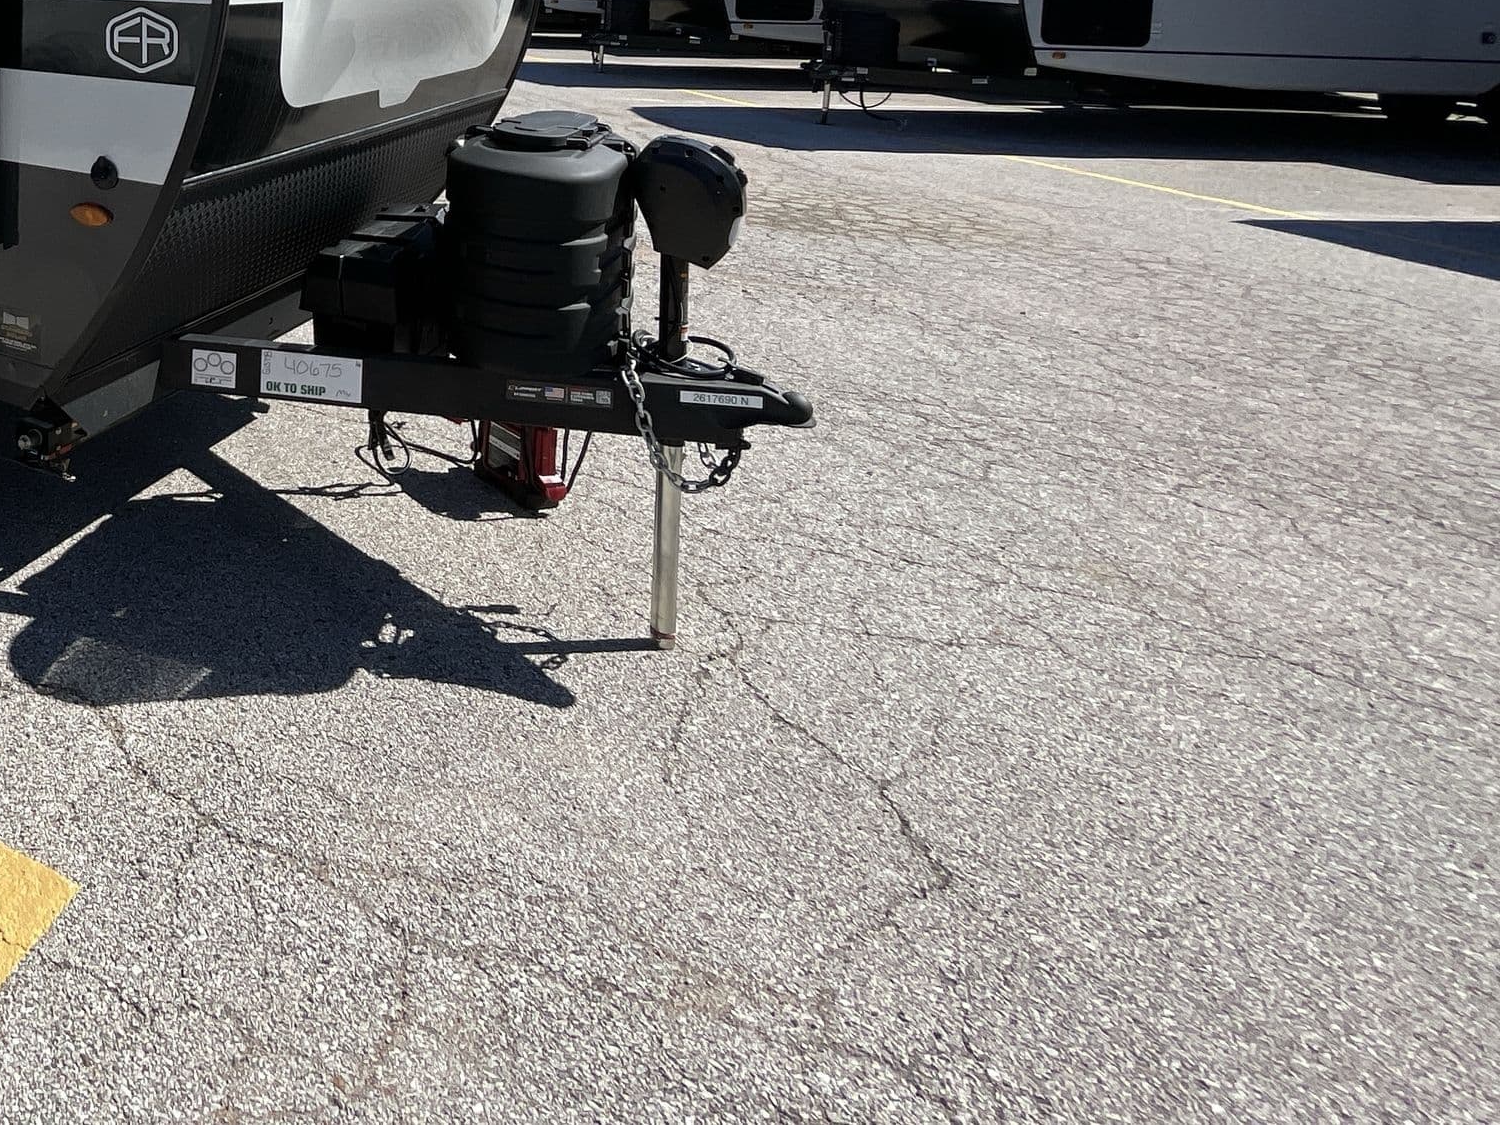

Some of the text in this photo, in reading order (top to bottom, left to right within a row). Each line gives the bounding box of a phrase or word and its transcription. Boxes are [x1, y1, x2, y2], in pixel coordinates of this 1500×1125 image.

[284, 356, 342, 378] 40675
[266, 381, 326, 397] OK TO SHIP
[693, 393, 749, 406] 2617690 N
